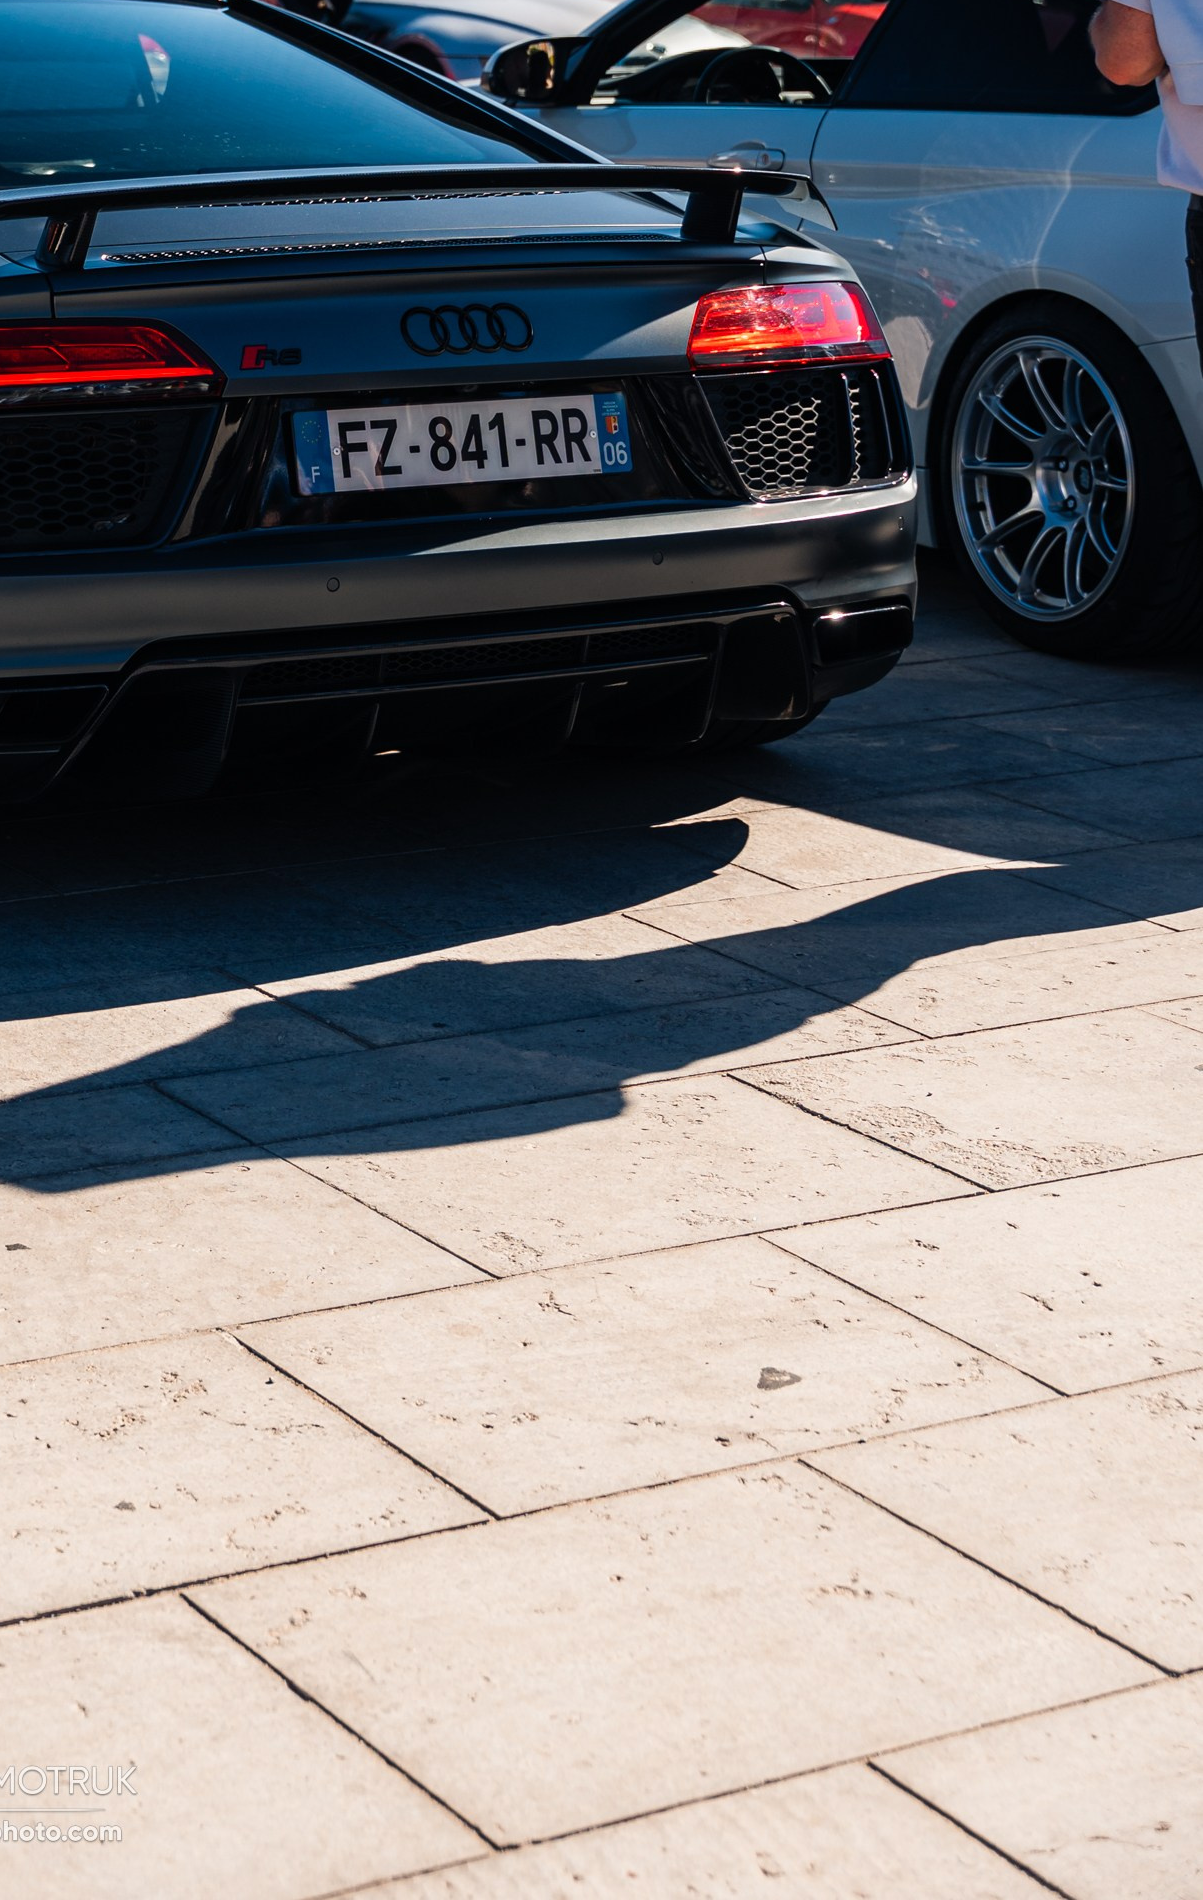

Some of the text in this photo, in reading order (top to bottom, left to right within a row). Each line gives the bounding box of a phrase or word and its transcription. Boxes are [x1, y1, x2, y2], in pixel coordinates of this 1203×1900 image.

[337, 408, 591, 478] FZ-841-RR
[603, 441, 628, 466] 06
[310, 466, 321, 483] F
